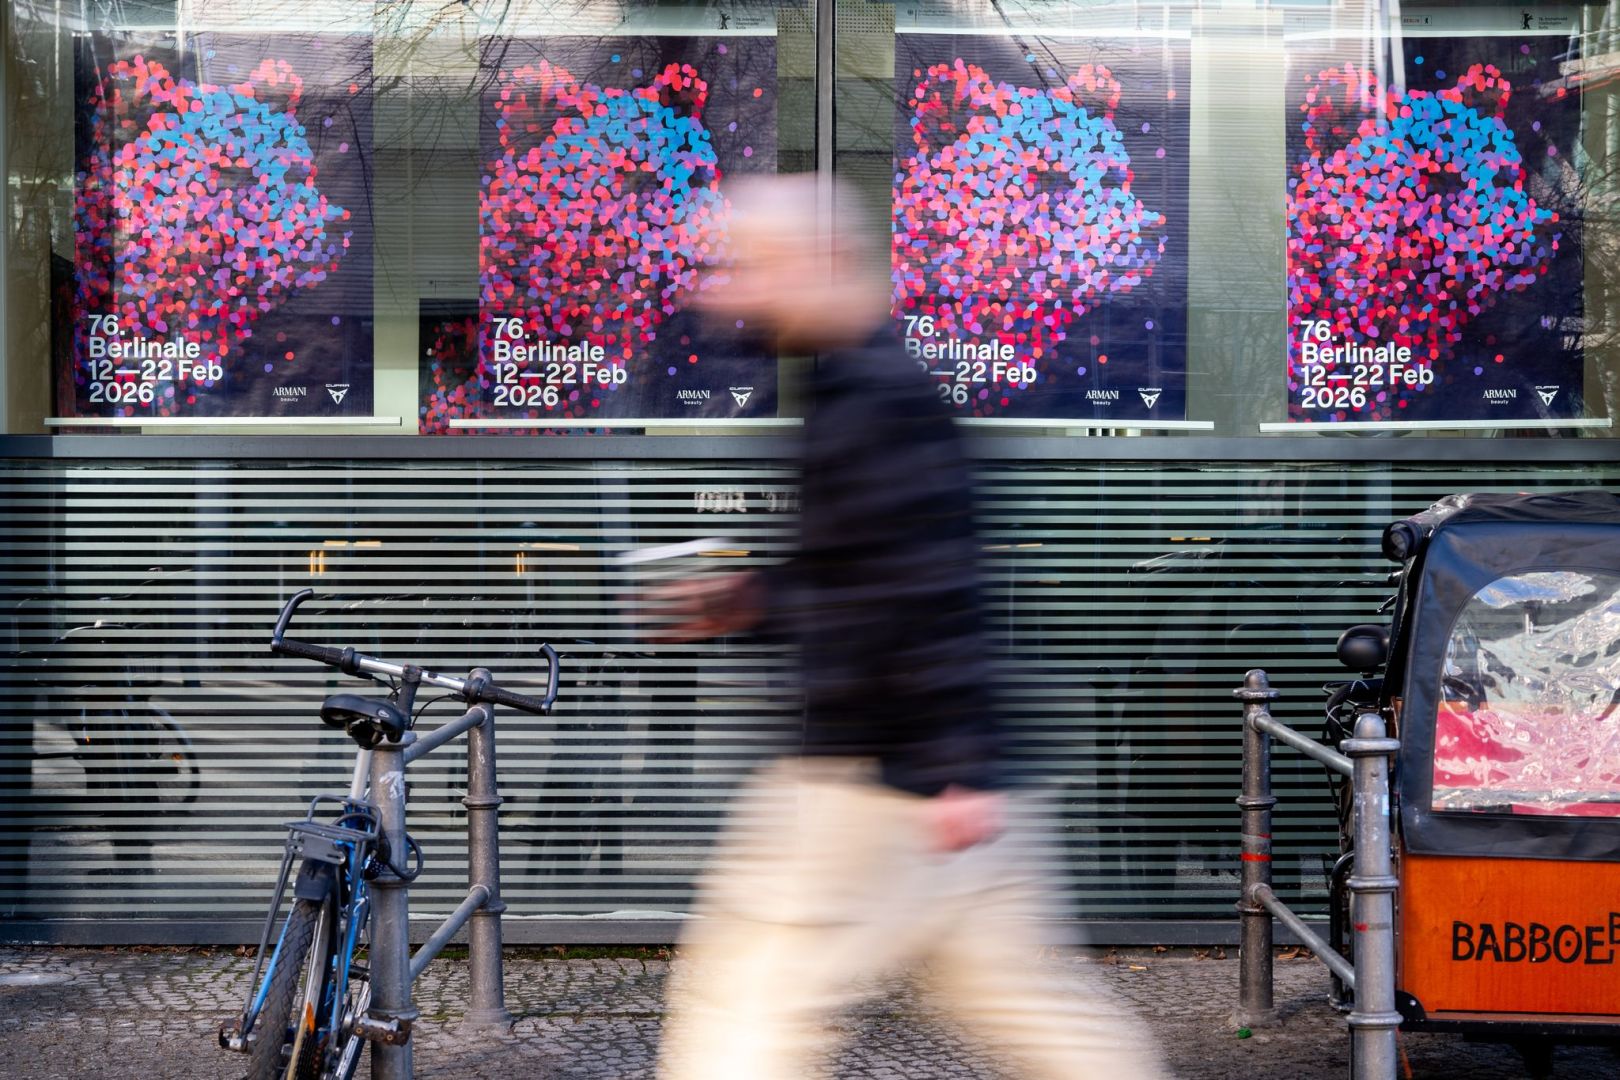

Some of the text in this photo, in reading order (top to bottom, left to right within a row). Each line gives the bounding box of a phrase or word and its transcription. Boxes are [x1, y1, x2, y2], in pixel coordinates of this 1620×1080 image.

[88, 314, 126, 336] 76.
[493, 317, 530, 339] 76.
[904, 315, 941, 337] 76.
[1300, 320, 1338, 342] 76.
[89, 336, 201, 358] Berlinale
[494, 340, 605, 362] Berlinale
[904, 337, 1015, 360] Berlinale
[1301, 341, 1411, 364] Berlinale
[178, 359, 224, 381] Feb
[582, 362, 628, 385] Feb
[992, 361, 1037, 384] Feb
[1389, 363, 1434, 386] Feb
[89, 381, 155, 403] 2026
[272, 386, 307, 396] ARMANI
[493, 385, 559, 407] 2026
[676, 389, 711, 399] ARMANI
[936, 382, 969, 405] 26
[1084, 389, 1120, 400] ARMANI
[1301, 386, 1367, 408] 2026
[1482, 388, 1517, 399] ARMANI
